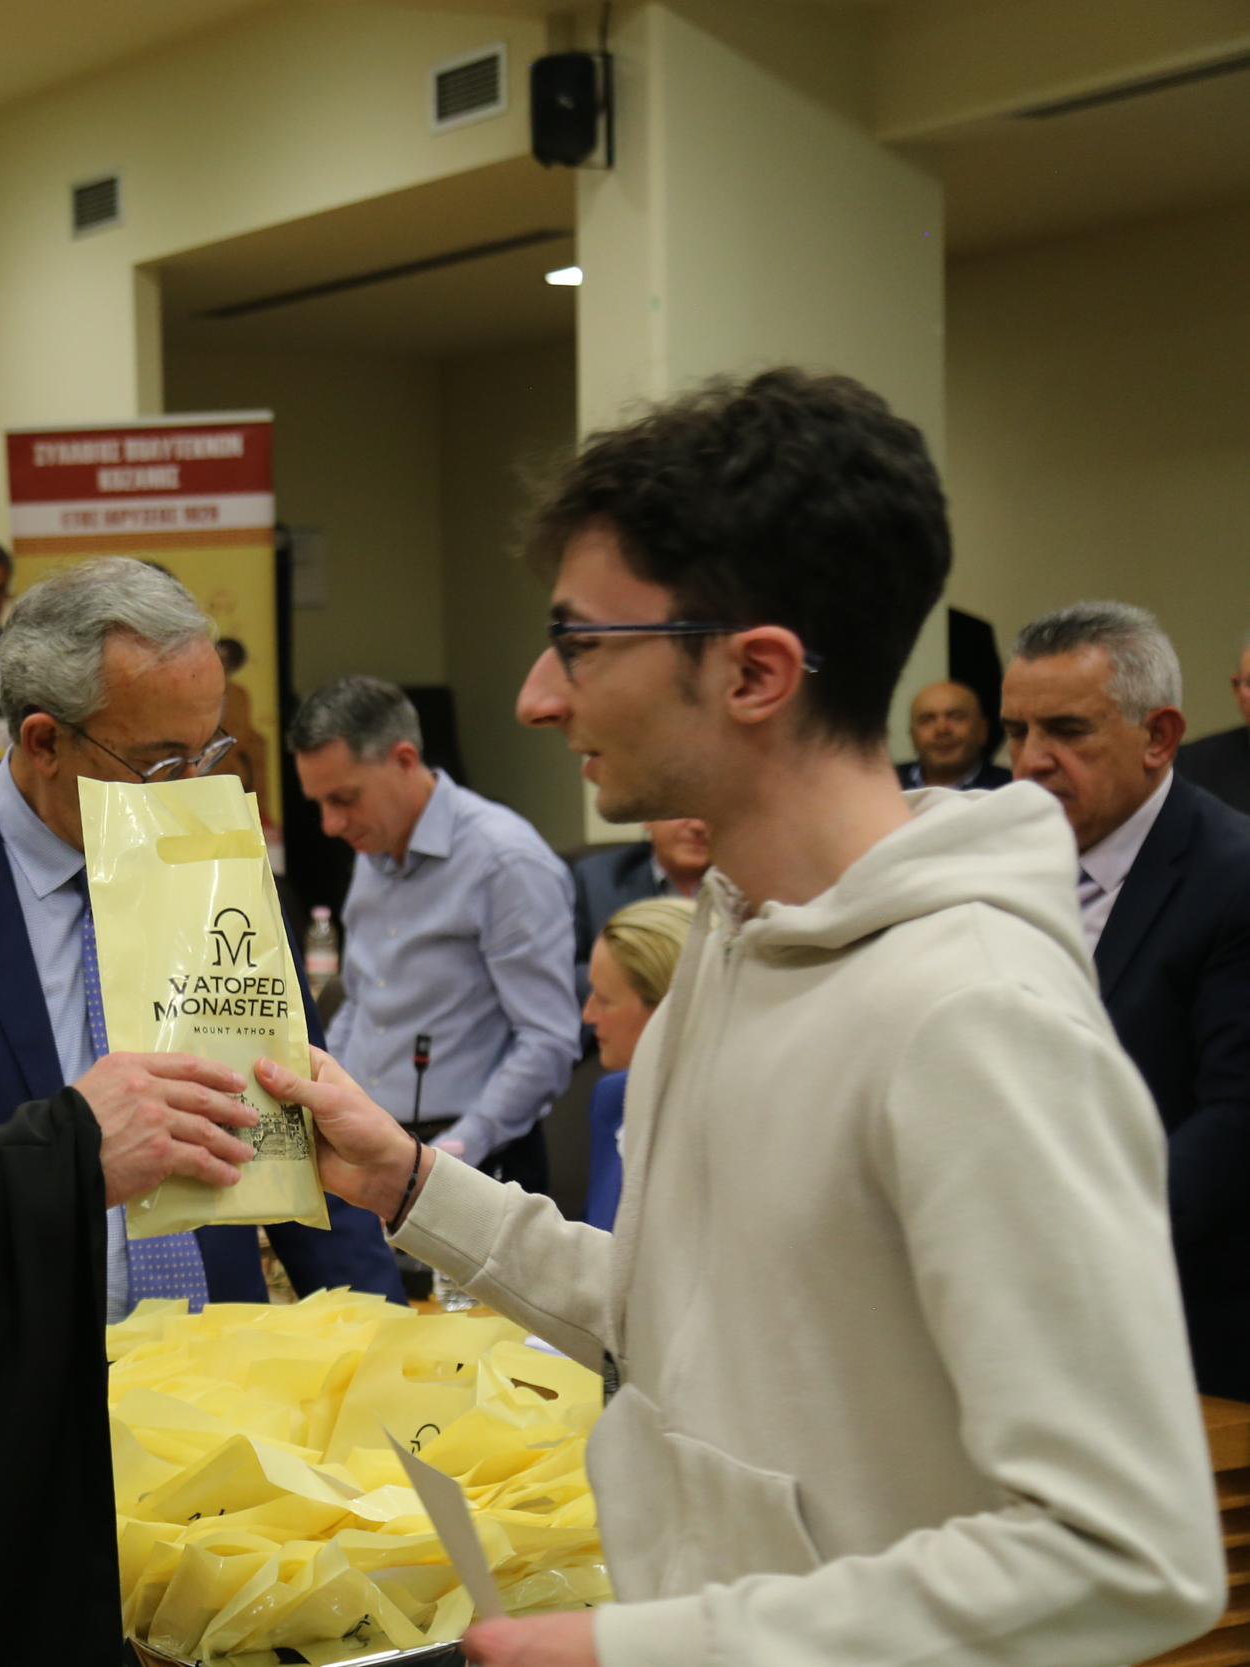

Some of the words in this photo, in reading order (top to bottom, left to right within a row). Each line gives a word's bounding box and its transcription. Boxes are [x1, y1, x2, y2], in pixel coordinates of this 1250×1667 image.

[168, 974, 285, 996] VATOPED
[153, 998, 288, 1021] MONASTER
[194, 1026, 231, 1035] MOUNT
[237, 1027, 275, 1037] ATHOS
